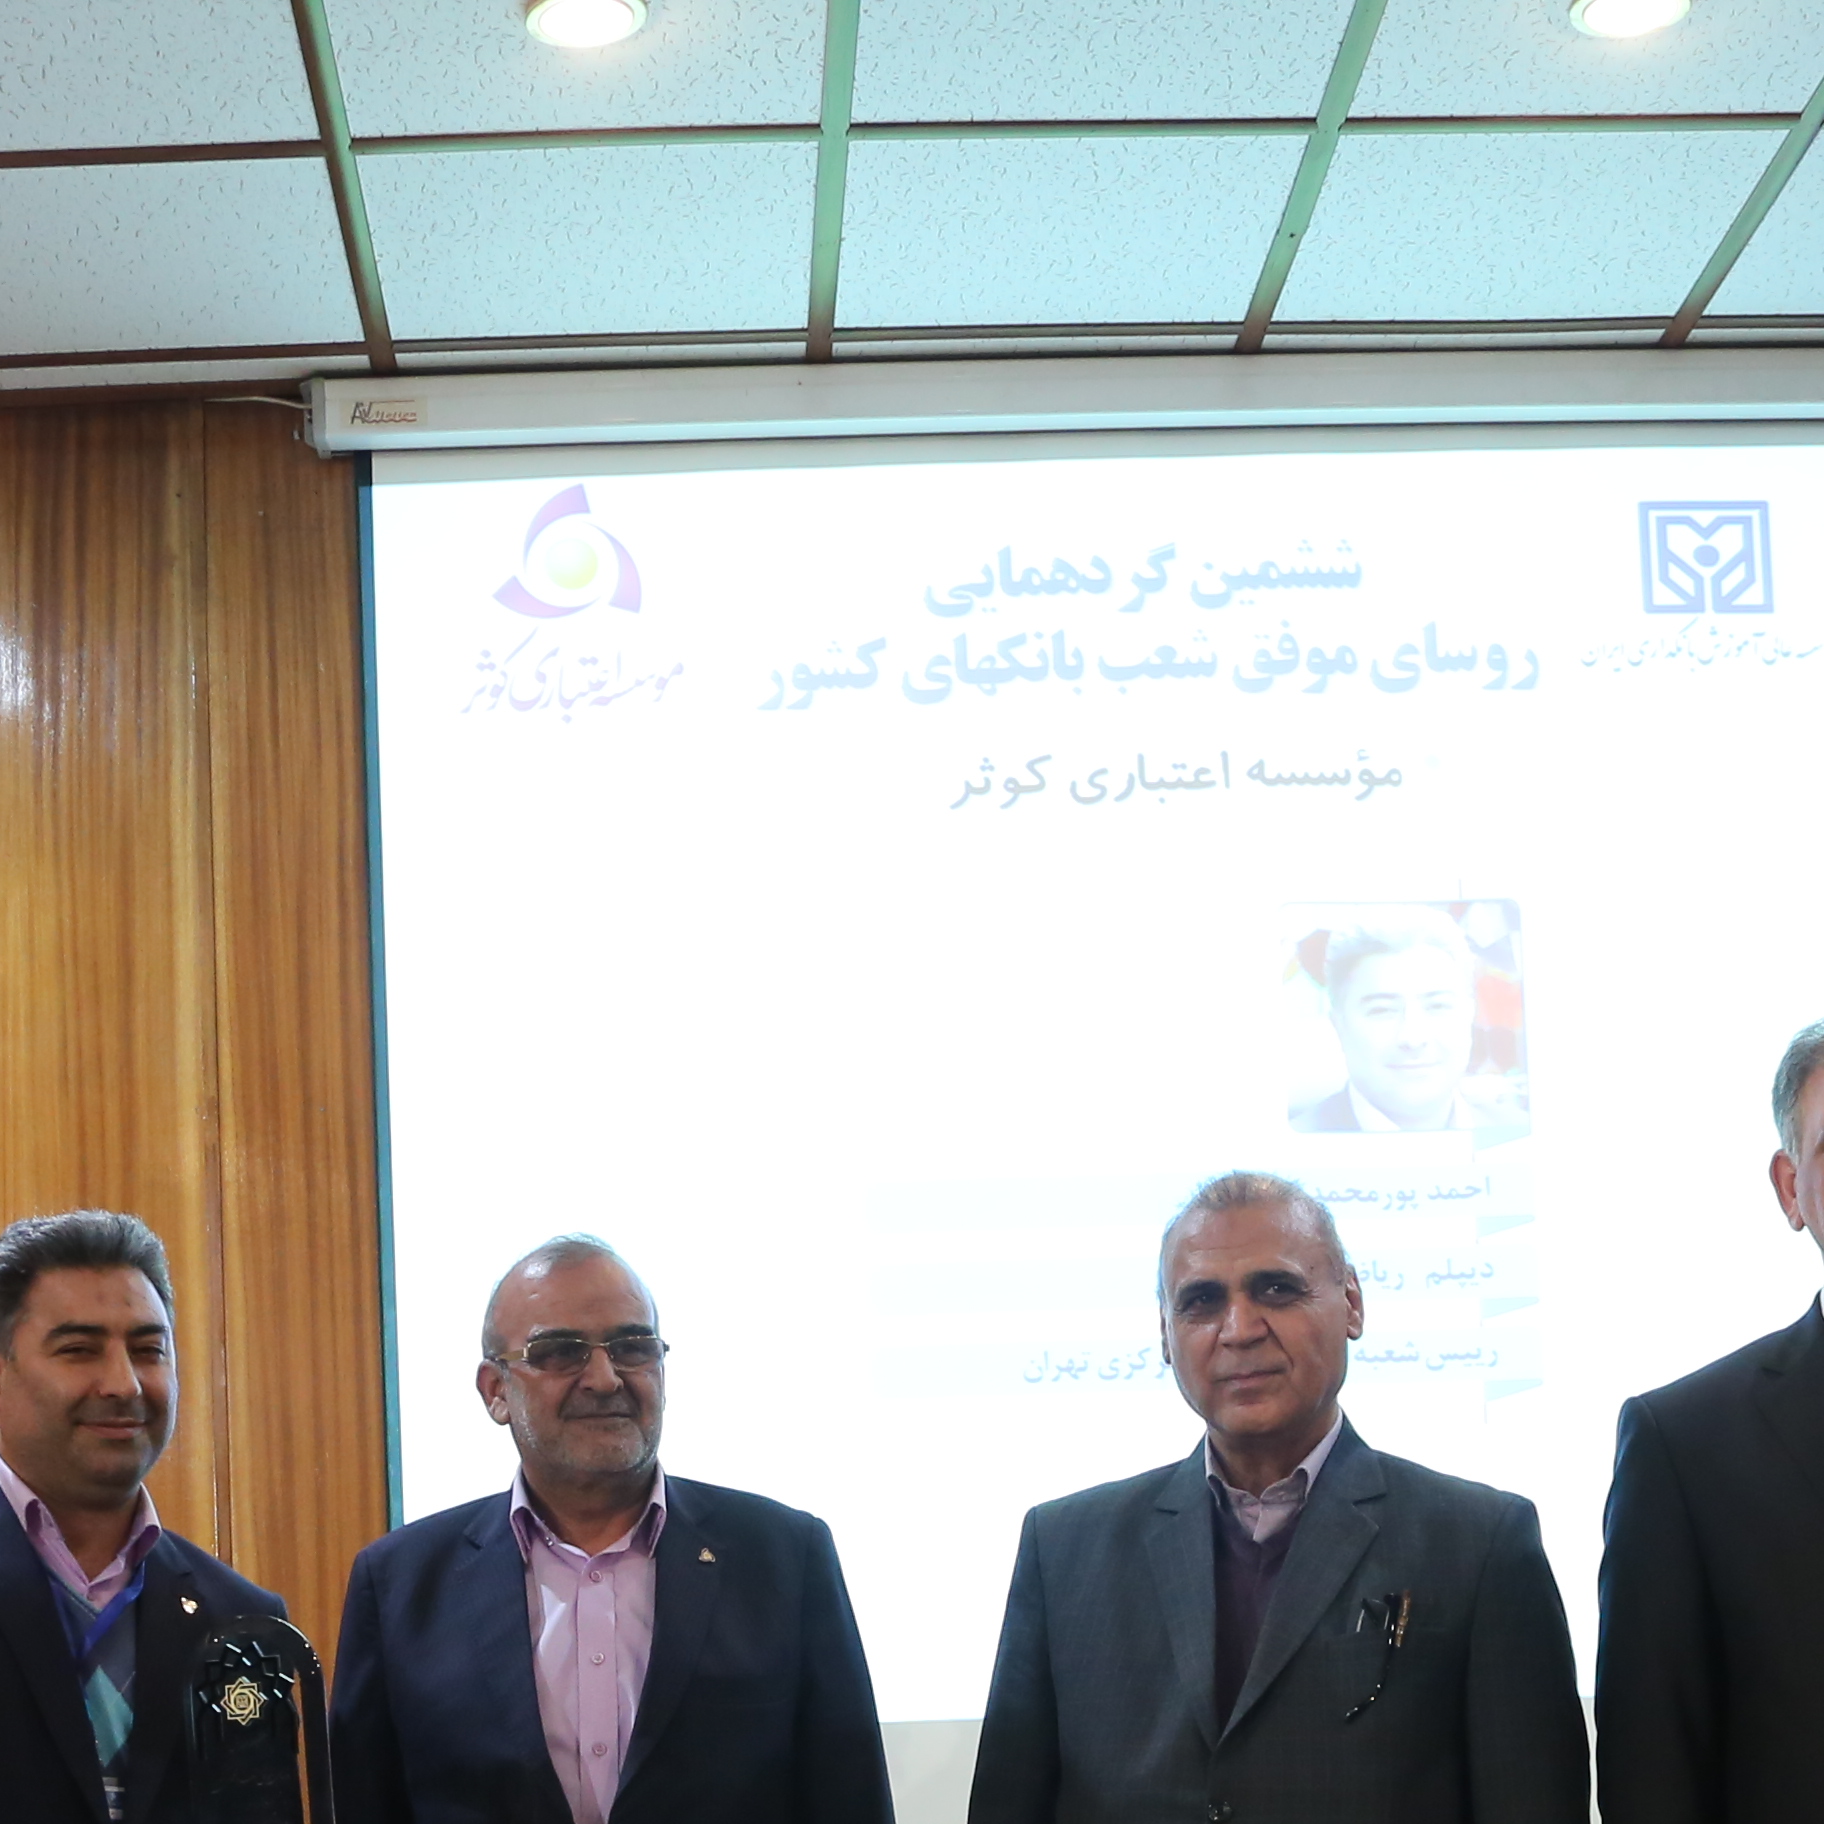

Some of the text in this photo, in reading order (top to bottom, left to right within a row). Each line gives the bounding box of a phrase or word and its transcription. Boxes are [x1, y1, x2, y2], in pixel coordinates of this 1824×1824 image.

[1189, 539, 1363, 610] ششمین
[757, 620, 1539, 711] روسای موفق شعب بانکهای کشور
[950, 748, 1403, 809] مؤسسه اعتباری کوثر
[1427, 1176, 1491, 1200] احمد
[1426, 1258, 1494, 1289] دیپلم
[1023, 1350, 1092, 1384] تهران
[1097, 1346, 1173, 1381] رکزی
[1353, 1340, 1420, 1370] شعبه
